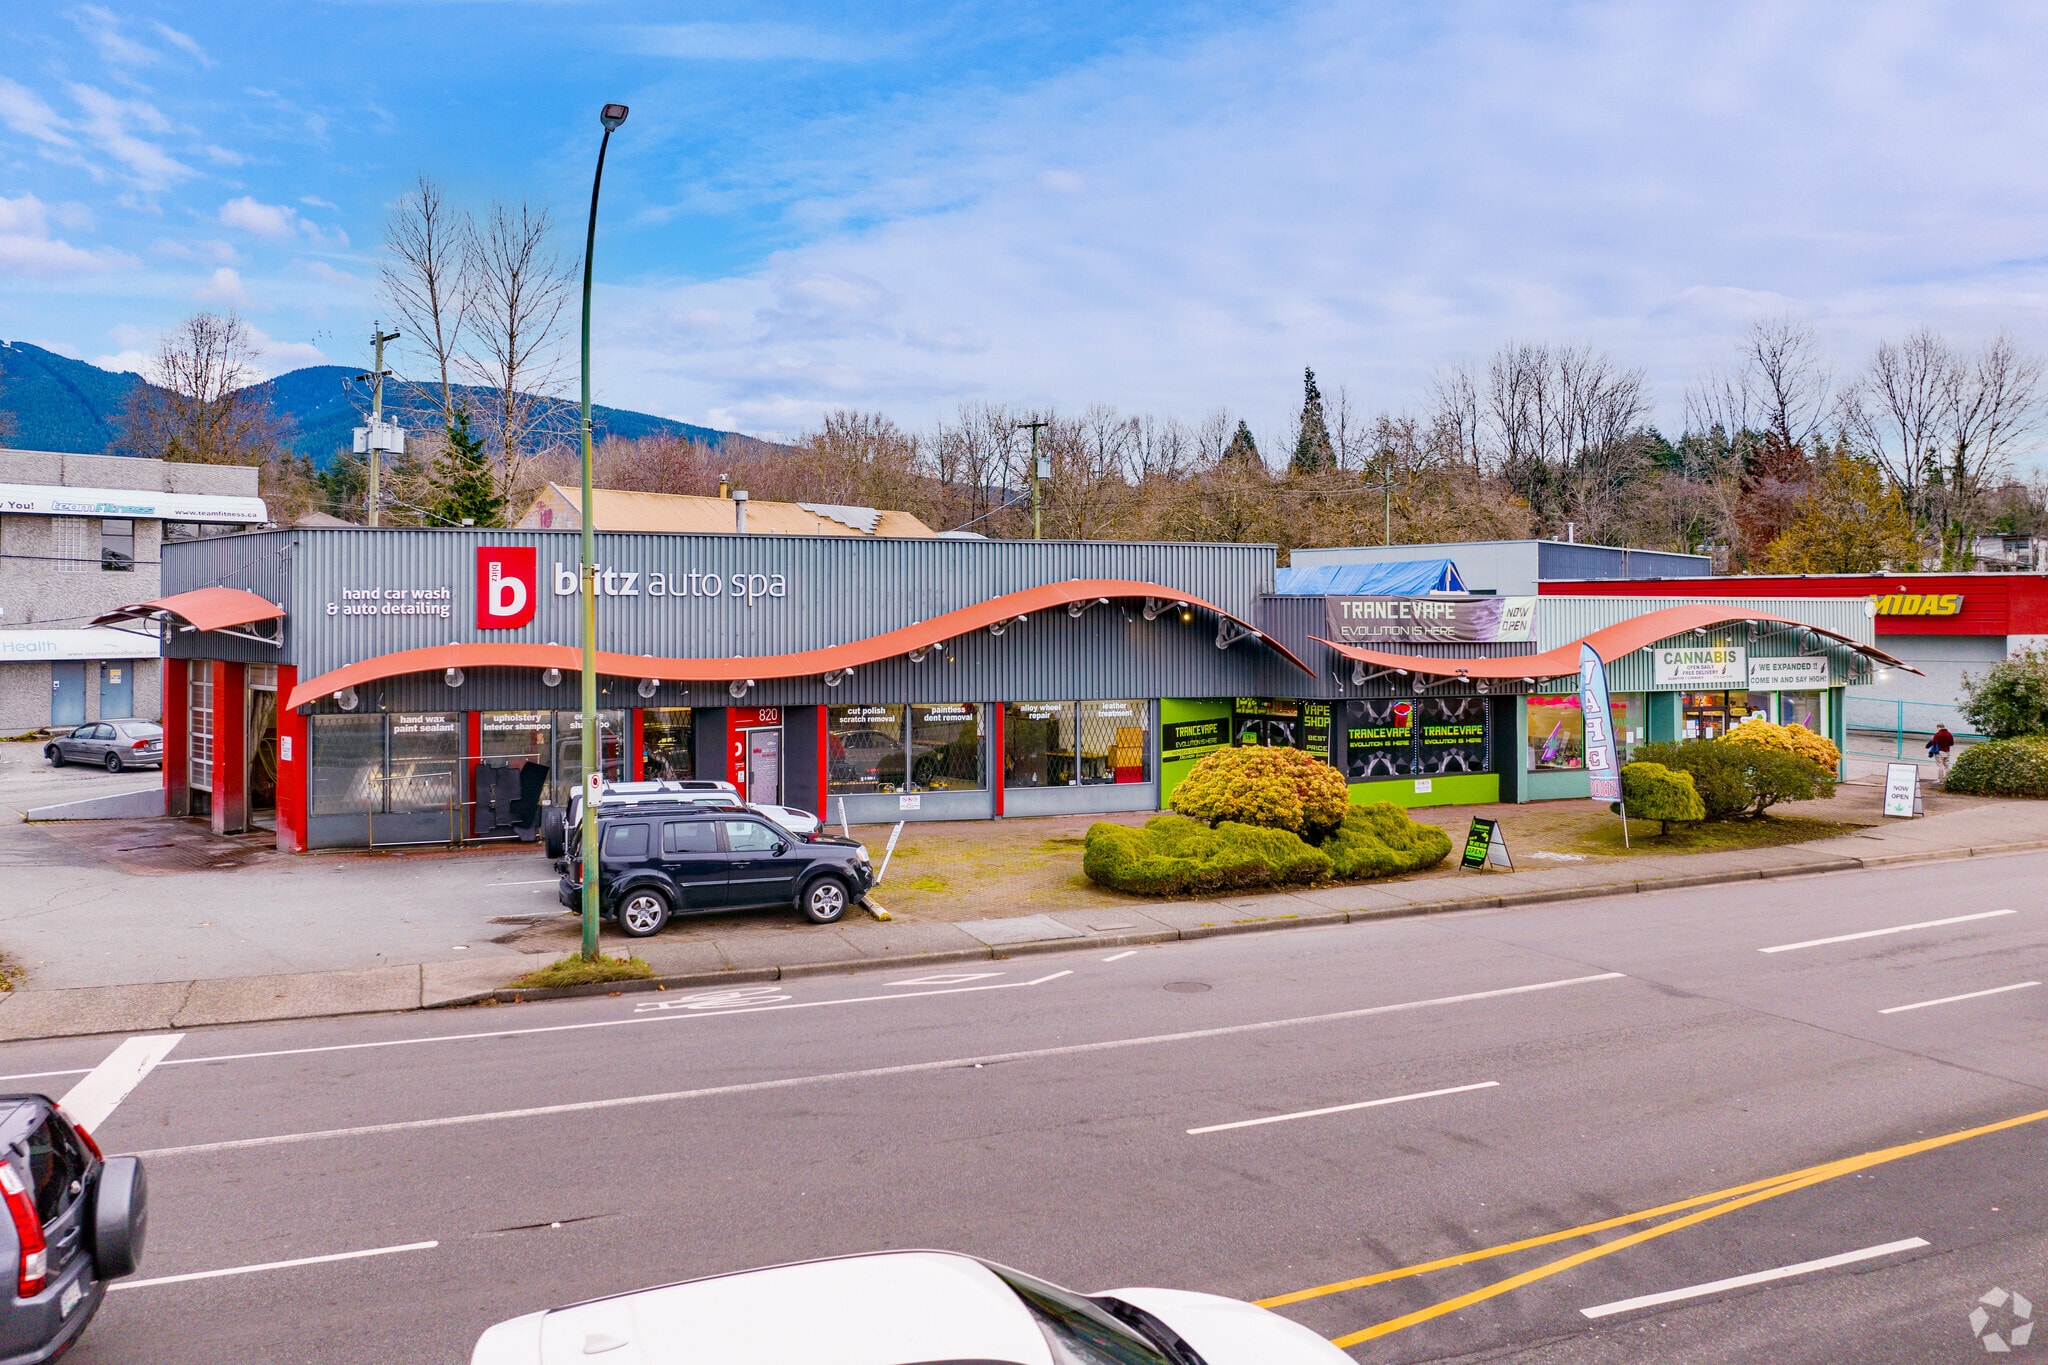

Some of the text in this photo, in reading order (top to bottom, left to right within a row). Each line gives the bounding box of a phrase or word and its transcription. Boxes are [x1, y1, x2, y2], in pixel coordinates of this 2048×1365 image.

[8, 501, 34, 510] You!
[491, 564, 499, 582] blitz
[647, 568, 722, 597] auto
[730, 573, 786, 606] spa
[342, 586, 450, 600] hand car wash
[326, 602, 450, 618] & auto detailing
[1869, 594, 1958, 615] MIDAS
[1340, 602, 1456, 620] TRANCEVAPE
[1506, 608, 1529, 618] NOW
[1342, 626, 1455, 636] EVOLUTION IS HERE
[1502, 620, 1526, 631] OPEN
[2, 641, 57, 652] Health
[1664, 651, 1736, 664] CANNABIS
[862, 706, 886, 716] polish
[932, 706, 966, 715] paintless
[1020, 704, 1038, 712] alloy
[1304, 706, 1330, 716] VAPE
[400, 716, 423, 724] hand
[494, 714, 542, 723] upholstery
[759, 708, 778, 721] 820
[943, 714, 972, 722] removal
[1029, 712, 1050, 720] repair
[484, 723, 552, 731] interior shampoo
[1304, 716, 1330, 727] SHOP
[394, 723, 454, 734] paint sealant
[1175, 724, 1218, 738] TRANCEVAPE
[1348, 728, 1410, 738] TRANCEVAPE
[1424, 725, 1483, 736] TRANCEVAPE
